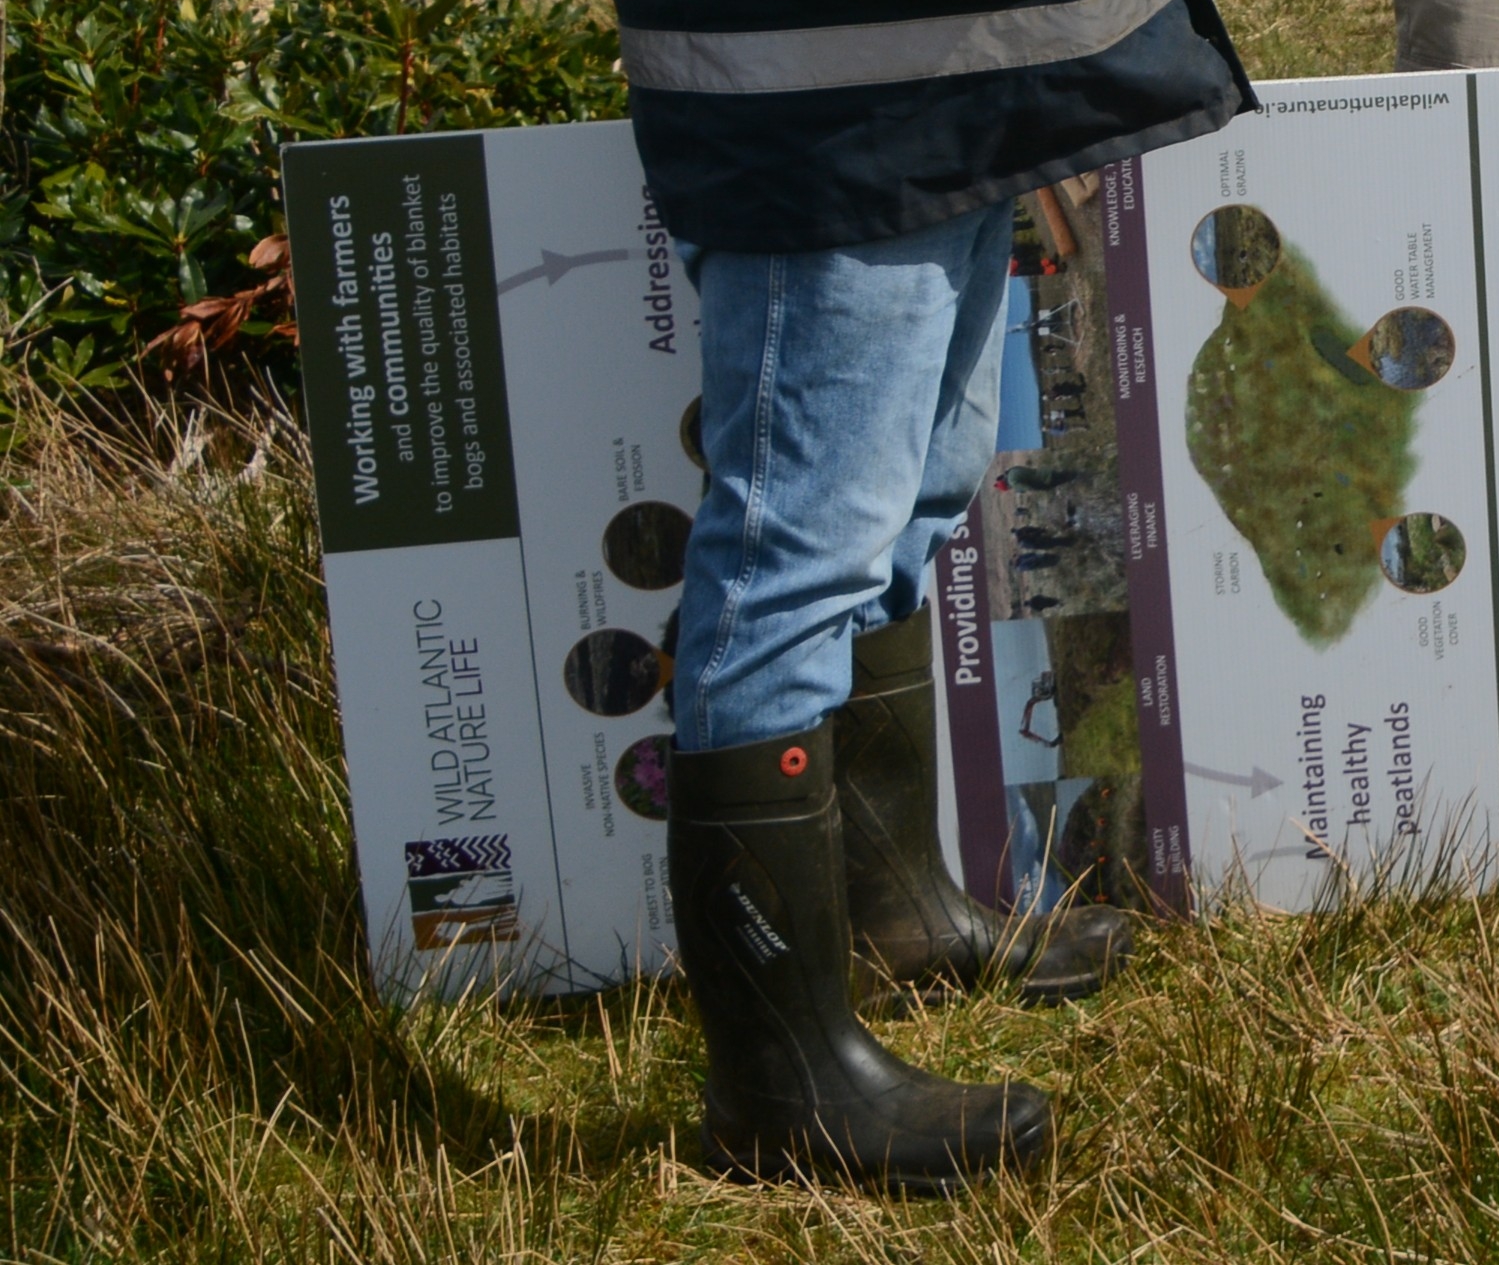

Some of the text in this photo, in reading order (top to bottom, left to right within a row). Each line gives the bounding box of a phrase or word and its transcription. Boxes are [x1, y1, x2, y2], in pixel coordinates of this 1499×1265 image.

[1254, 93, 1450, 118] wildatlanticnature.ie
[1219, 149, 1230, 197] OPTIMAL
[1235, 149, 1247, 196] GRAZING
[1105, 170, 1120, 246] KNOWLEDGE,
[1394, 269, 1405, 301] GOOD
[1407, 233, 1420, 300] WATER TABLE
[1422, 223, 1435, 298] MANAGEMENT
[330, 194, 380, 505] Working with farmers
[368, 231, 414, 463] and communities
[402, 173, 453, 514] to improve the quality of blanket
[440, 192, 487, 490] bogs and associated habitats
[1114, 314, 1131, 400] MONITORING &
[1132, 327, 1146, 383] RESEARCH
[613, 437, 629, 502] BARE SOIL &
[630, 444, 645, 492] EROSION
[1127, 492, 1142, 560] LEVERAGING
[1144, 502, 1158, 548] FINANCE
[575, 569, 592, 631] BURNING &
[592, 570, 608, 626] WILDFIRES
[1214, 551, 1225, 595] STORING
[1229, 551, 1240, 594] CARBON
[946, 547, 982, 685] Providing
[1418, 616, 1429, 647] GOOD
[1432, 601, 1444, 661] VEGETATION
[1448, 612, 1458, 645] COVER
[413, 599, 465, 826] WILD ATLANTIC
[1141, 677, 1153, 707] LAND
[1156, 655, 1170, 726] RESTORATION
[450, 637, 497, 821] NATURE LIFE
[580, 763, 595, 810] INVASIVE
[594, 731, 616, 837] NON-NATIVE SPECIES
[1296, 693, 1330, 860] Maintaining
[1341, 723, 1372, 825] healthy
[1384, 702, 1422, 836] peatlands
[1153, 828, 1166, 875] CAPACITY
[1168, 825, 1181, 874] BUILDING
[642, 853, 660, 930] FOREST TO BOG
[738, 895, 787, 950] DUNLOP
